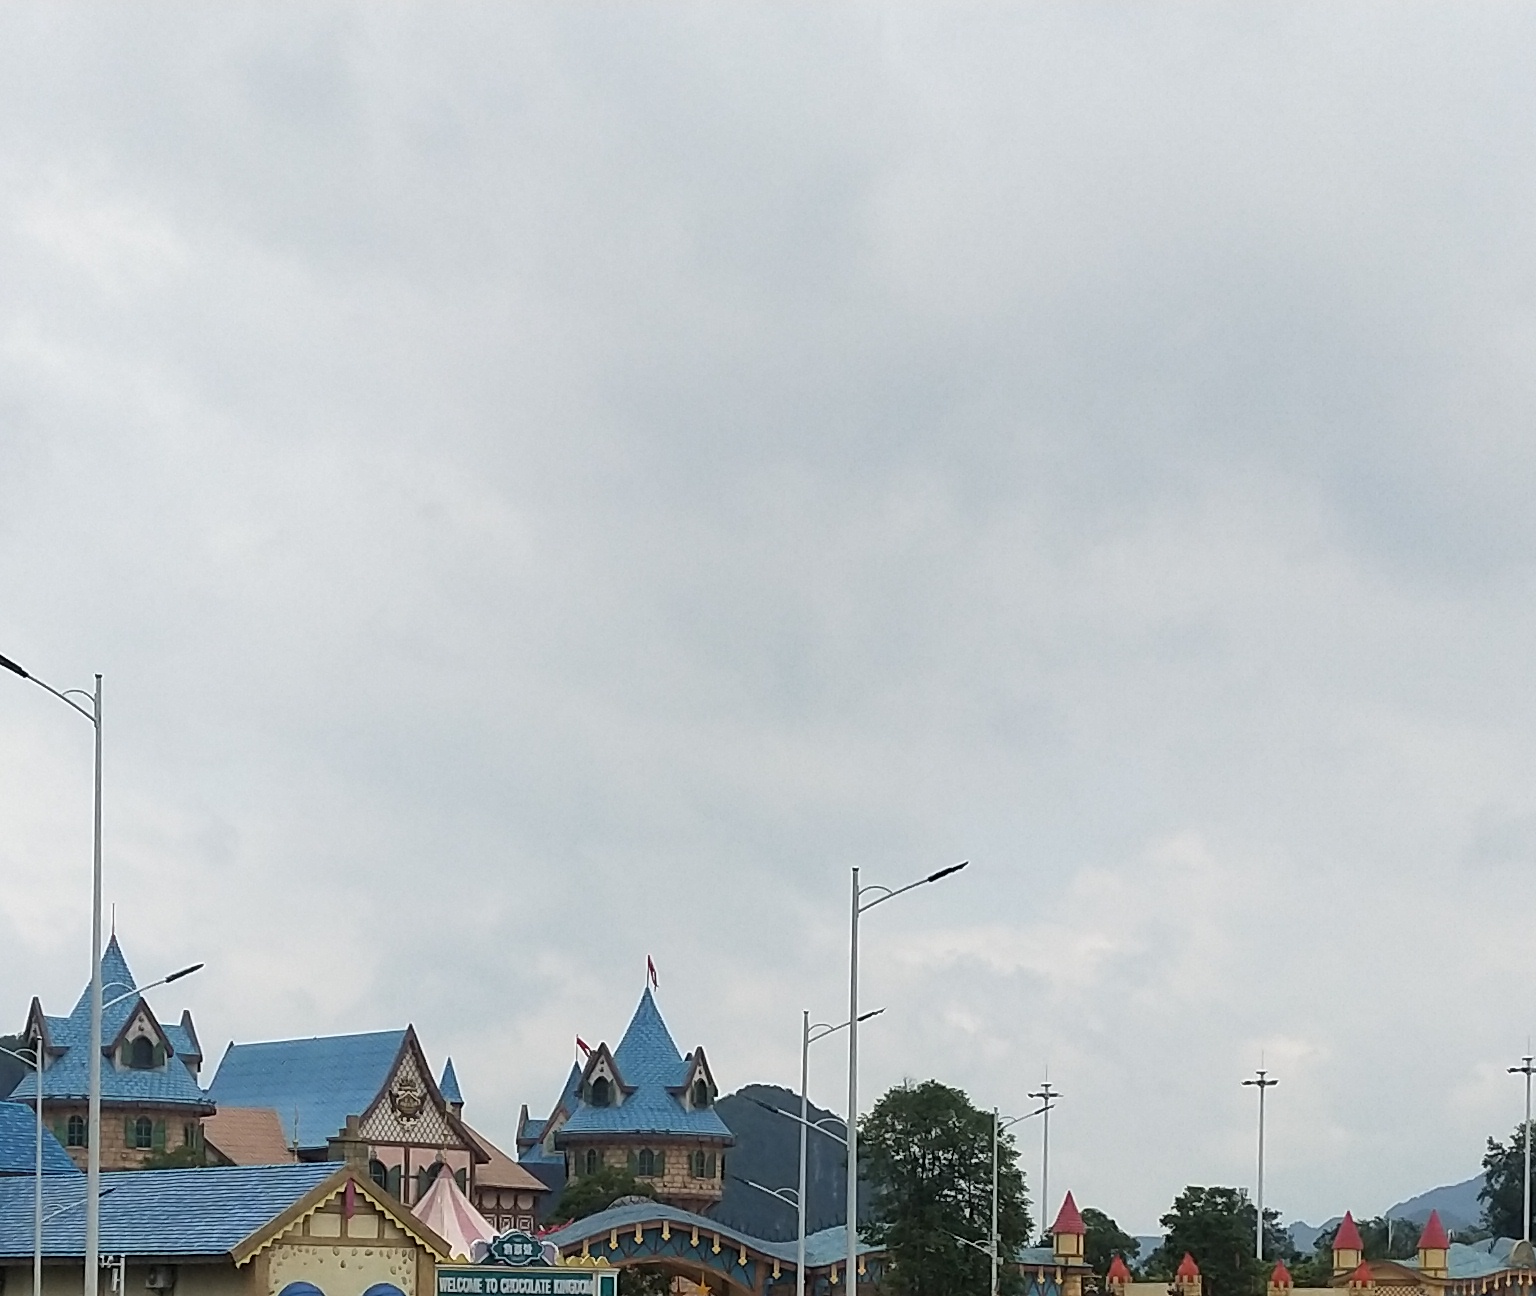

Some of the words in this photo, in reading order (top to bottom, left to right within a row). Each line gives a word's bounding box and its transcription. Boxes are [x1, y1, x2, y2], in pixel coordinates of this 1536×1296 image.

[439, 1277, 483, 1294] WELCOME
[484, 1278, 498, 1294] TO
[499, 1278, 552, 1295] CHOCOLATE
[553, 1279, 593, 1295] KINGDOM
